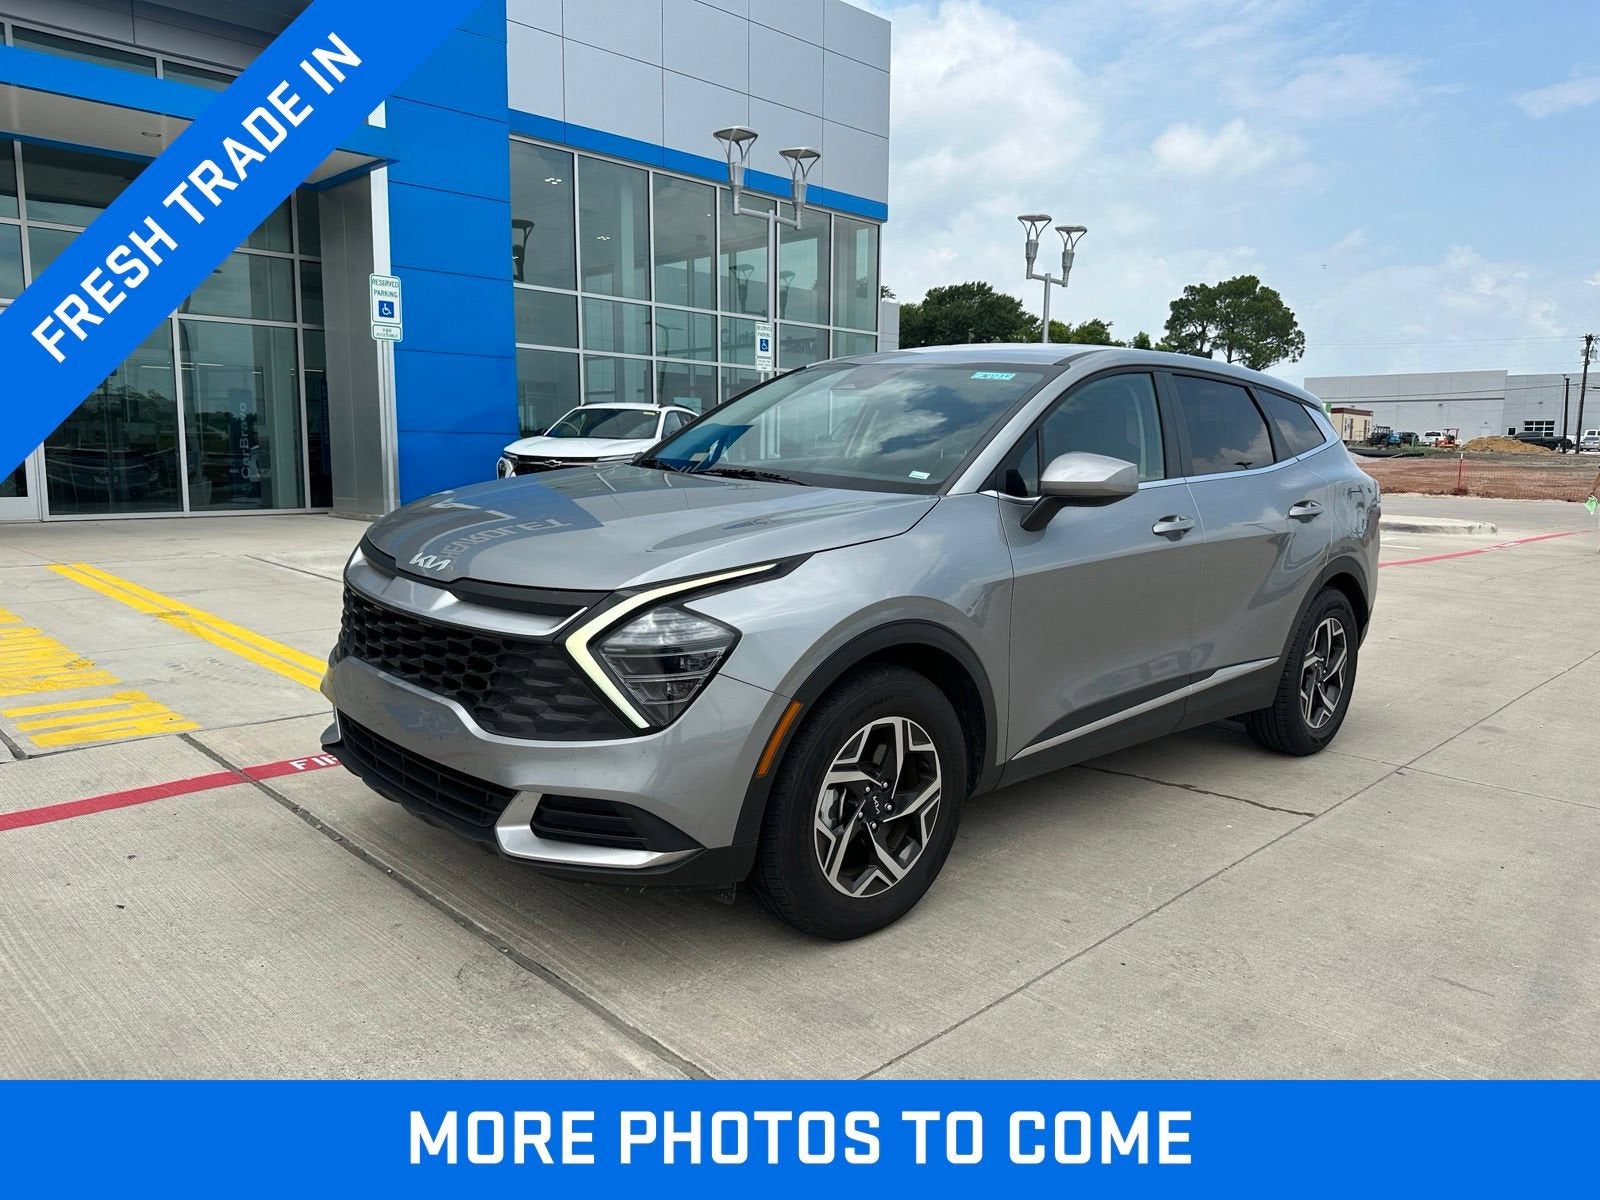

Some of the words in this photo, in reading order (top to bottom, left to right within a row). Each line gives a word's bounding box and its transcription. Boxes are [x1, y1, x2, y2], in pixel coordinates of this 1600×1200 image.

[372, 278, 399, 288] RESERVED
[374, 289, 398, 298] PARKING
[240, 402, 250, 479] CarBravo
[409, 552, 452, 572] KIA
